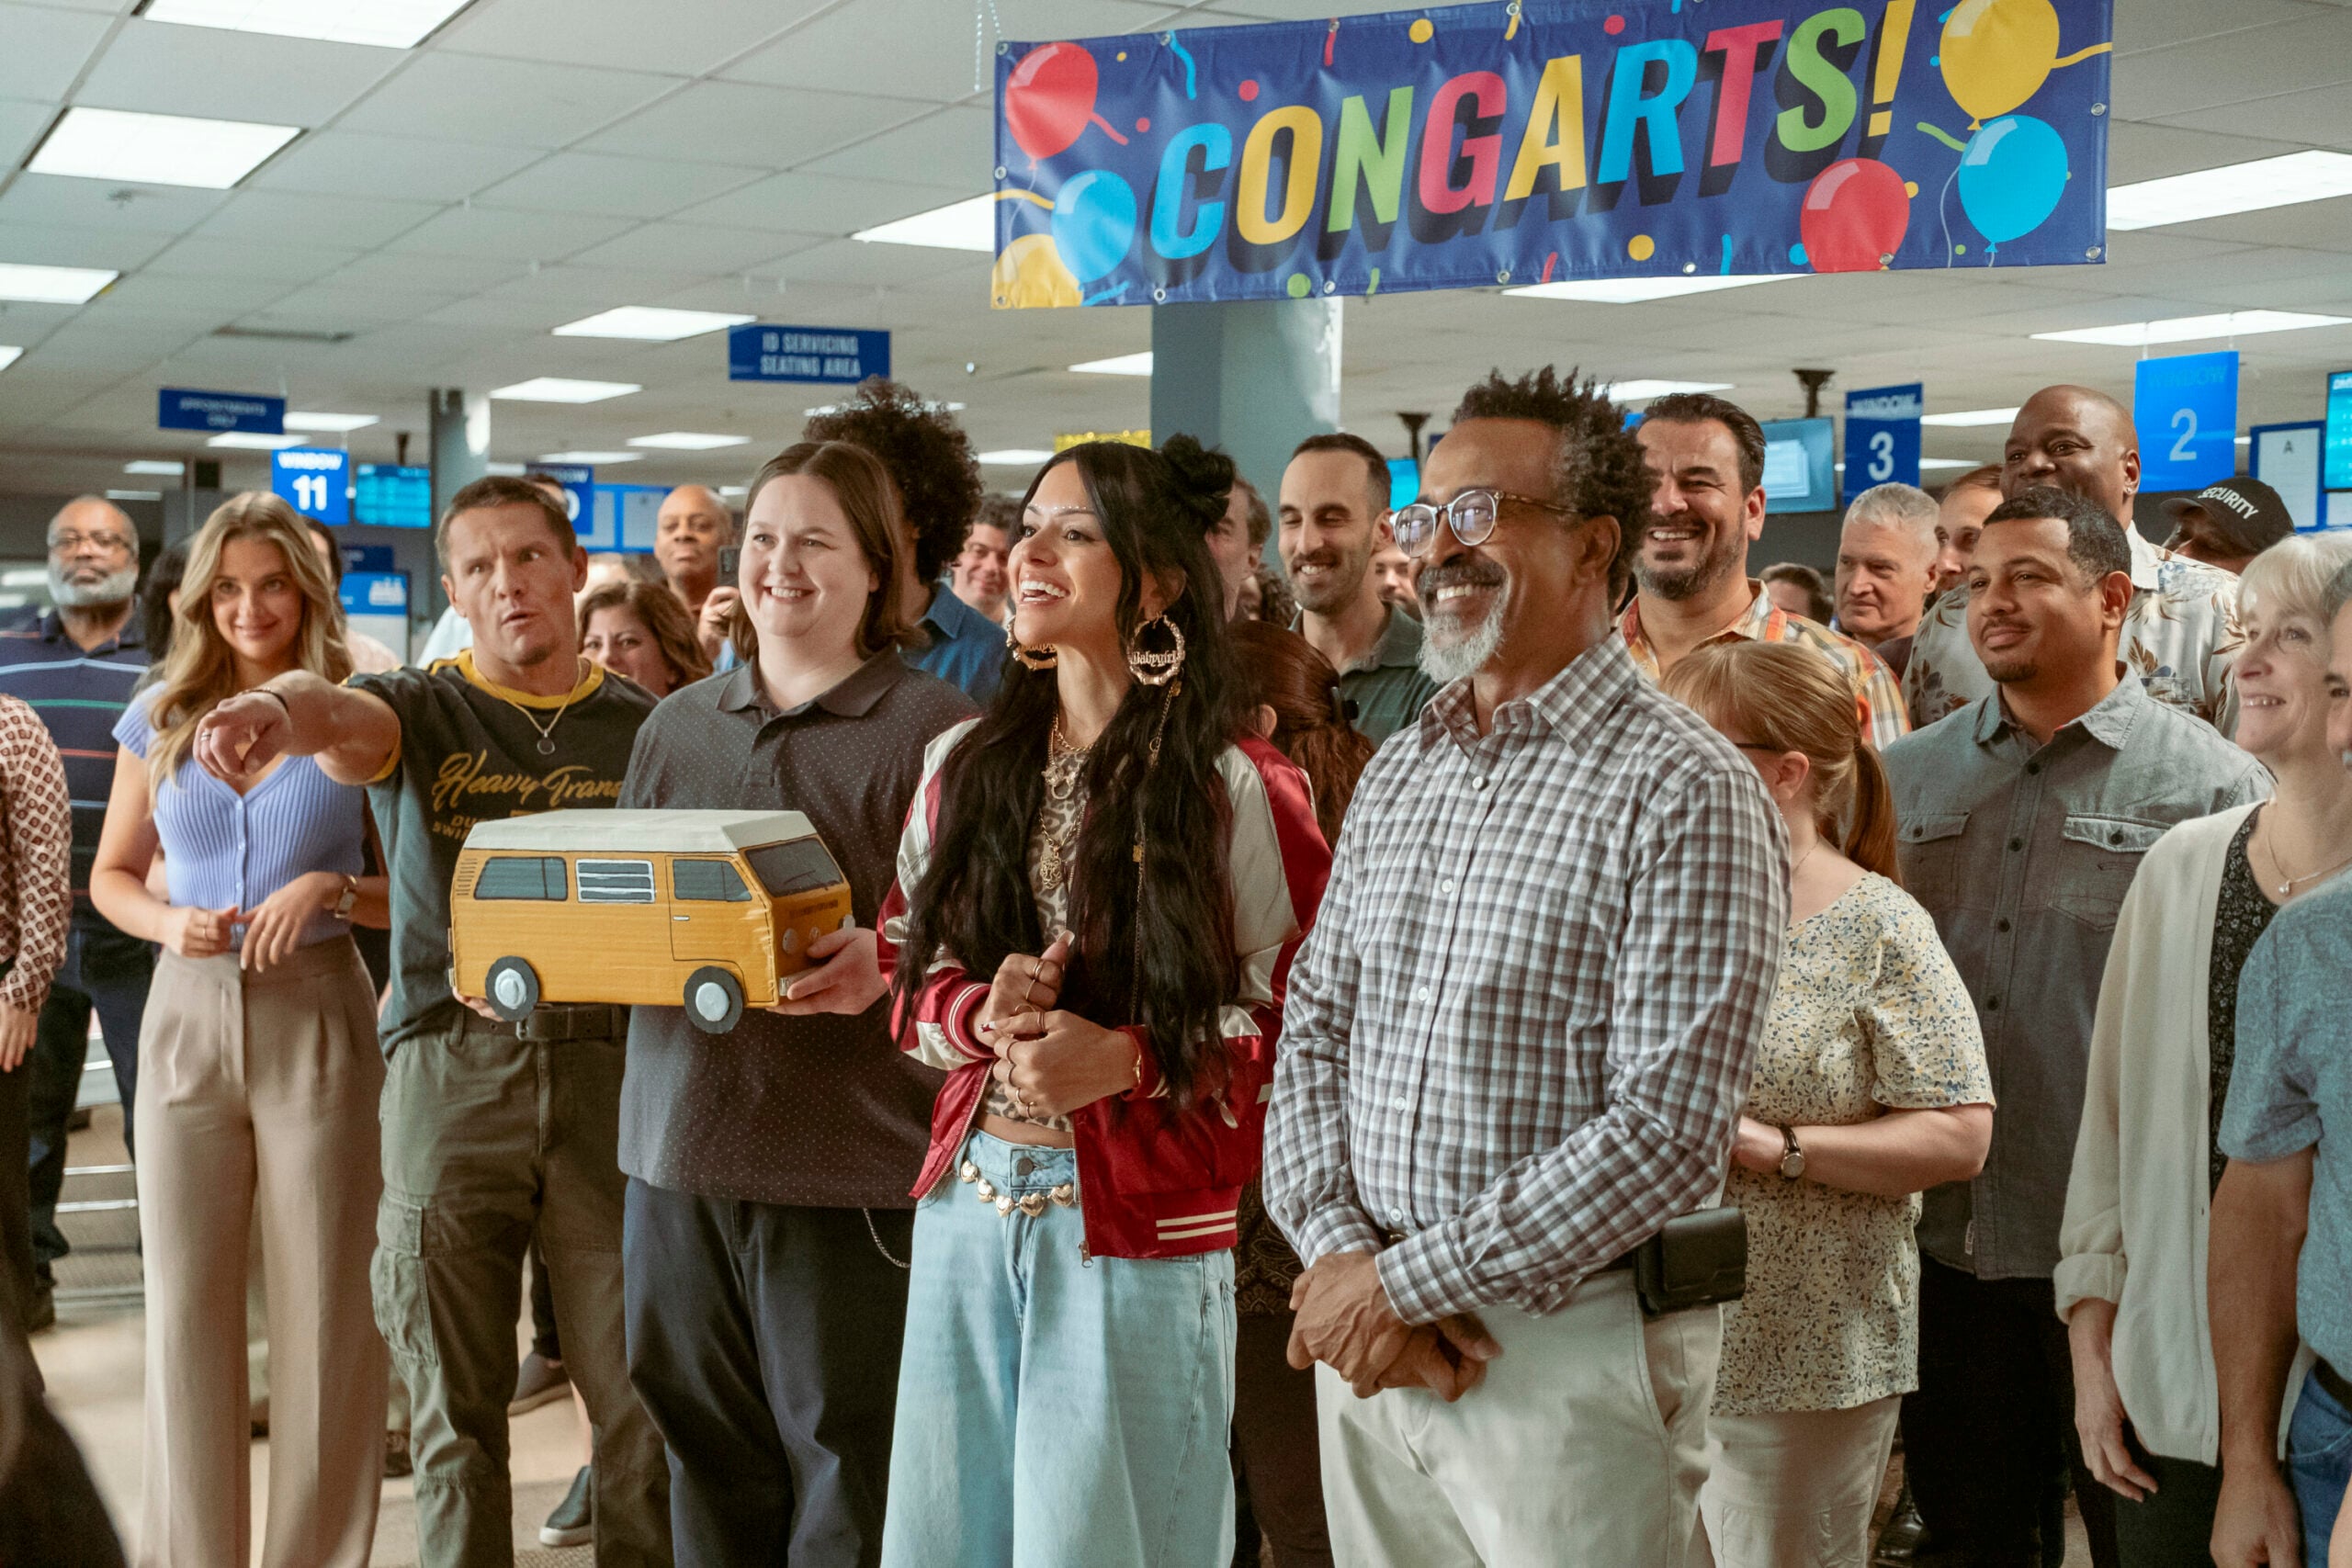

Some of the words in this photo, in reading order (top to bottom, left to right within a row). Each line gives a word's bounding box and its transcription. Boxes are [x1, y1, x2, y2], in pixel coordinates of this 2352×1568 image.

[1148, 0, 1913, 261] CONGARTS!
[782, 333, 859, 355] SERVICING
[760, 355, 820, 376] SEATING
[823, 357, 861, 378] AREA
[2169, 408, 2198, 461] 2
[2283, 439, 2294, 454] A
[277, 451, 343, 470] WINDOW
[1868, 431, 1894, 481] 3
[292, 475, 327, 511] 11
[2198, 487, 2259, 520] SECURITY
[432, 749, 542, 812] Heavy
